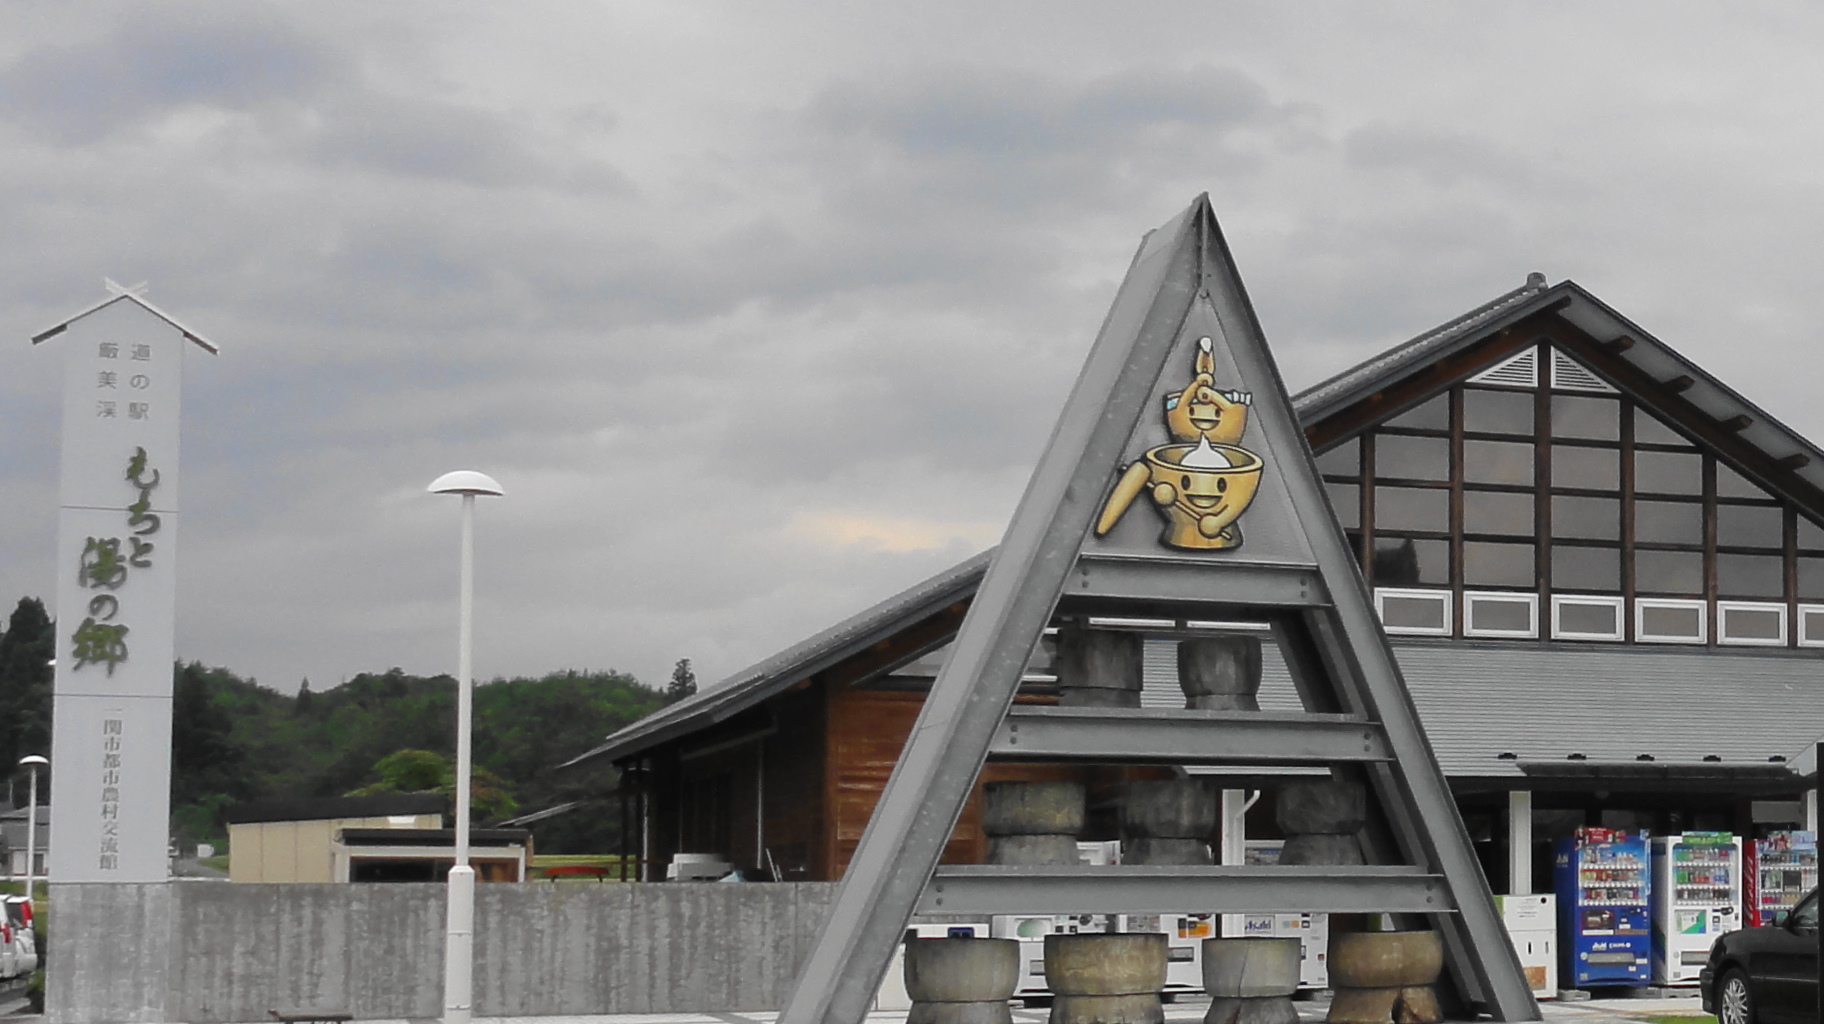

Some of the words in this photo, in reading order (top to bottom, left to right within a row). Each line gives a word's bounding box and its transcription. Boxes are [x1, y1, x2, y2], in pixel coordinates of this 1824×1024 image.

[97, 341, 119, 418] 厳美渓
[129, 343, 151, 420] 道の駅
[125, 445, 161, 568] もちと
[72, 536, 130, 678] 湯の郷
[99, 707, 123, 871] 一関市都市農村交流館
